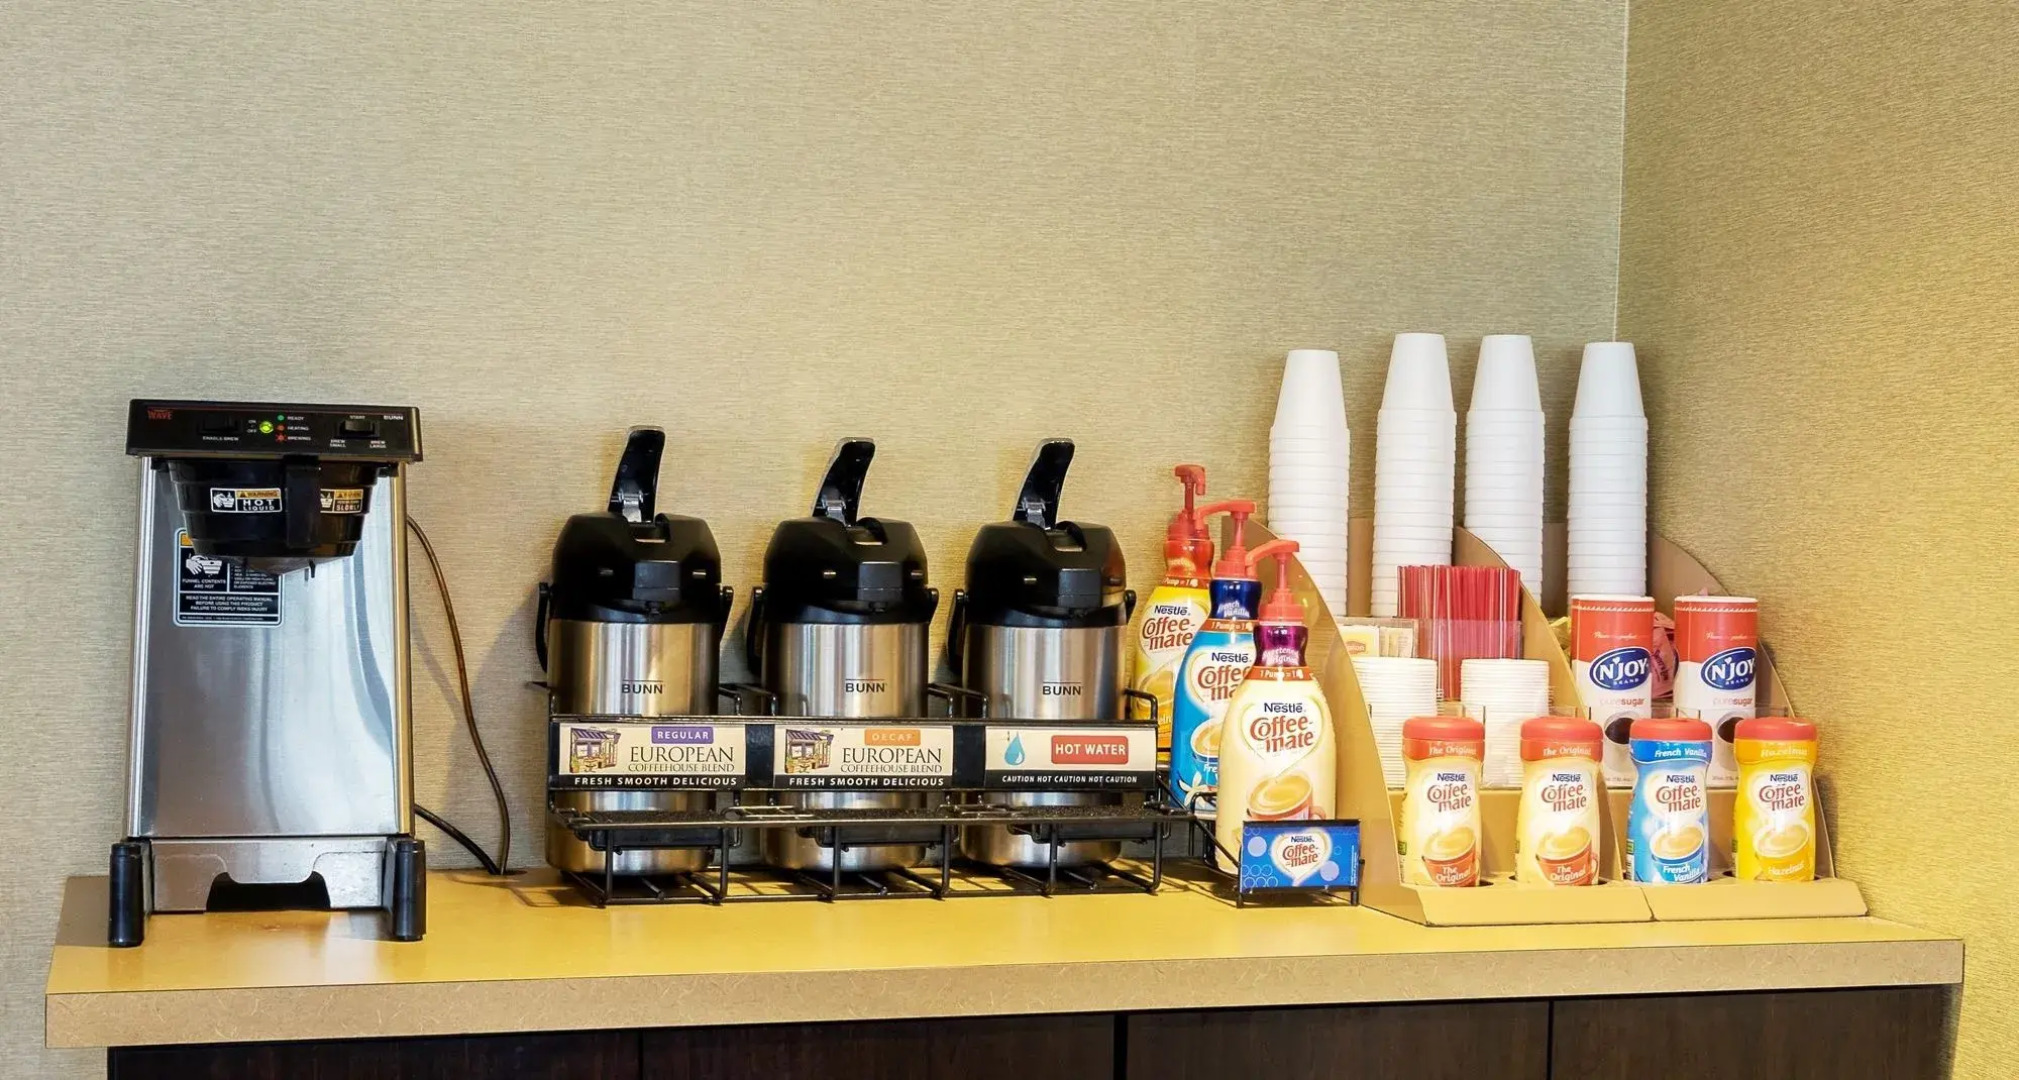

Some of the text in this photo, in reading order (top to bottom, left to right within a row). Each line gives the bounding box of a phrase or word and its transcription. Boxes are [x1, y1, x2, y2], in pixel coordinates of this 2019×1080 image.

[1150, 632, 1194, 650] mate
[621, 683, 663, 694] BUNN
[846, 682, 885, 693] BUNN
[1042, 686, 1082, 696] BUNN
[657, 731, 709, 740] REGULAR
[872, 733, 915, 741] DECAF
[1265, 731, 1314, 752] mate
[630, 746, 734, 762] EUROPEAN
[1056, 744, 1126, 755] HOT WATER
[1655, 748, 1682, 757] French
[842, 748, 941, 764] EUROPEAN
[628, 763, 734, 772] COFFEEHOUSE BLEND
[840, 764, 942, 773] COFFEEHOUSE BLEND
[575, 777, 737, 786] FRESH SMOOTH DELICIOUS
[789, 777, 944, 786] FRESH SMOOTH DELICIOUS
[1438, 796, 1471, 812] mate
[1553, 796, 1587, 812] mate
[1668, 797, 1701, 812] mate
[1772, 795, 1805, 811] mate
[1291, 853, 1318, 867] mate
[1436, 865, 1471, 883] Original
[1550, 864, 1586, 881] Original
[1664, 864, 1690, 873] French
[1674, 868, 1700, 882] Vanilla
